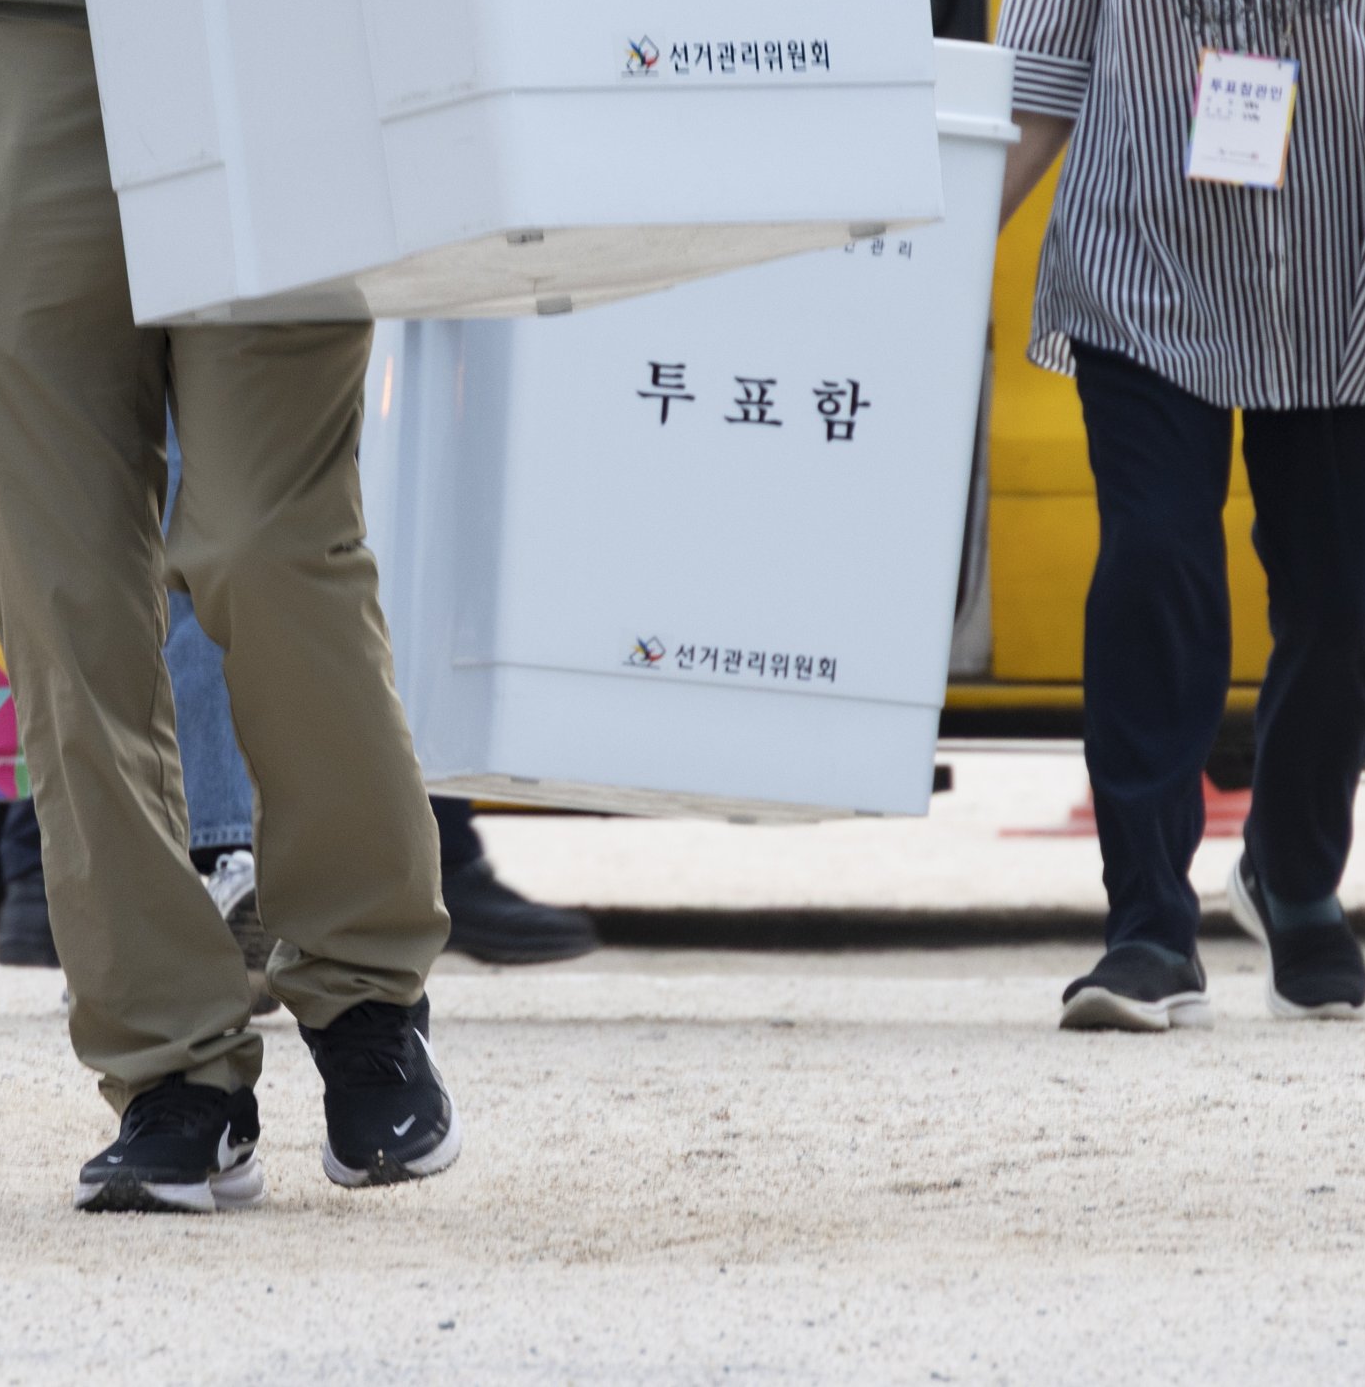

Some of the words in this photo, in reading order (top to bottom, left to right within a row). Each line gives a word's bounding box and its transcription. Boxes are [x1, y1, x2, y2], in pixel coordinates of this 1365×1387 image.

[669, 39, 831, 74] 선거관리위원회
[637, 361, 871, 442] 투표함
[675, 644, 837, 683] 선거관리위원회
